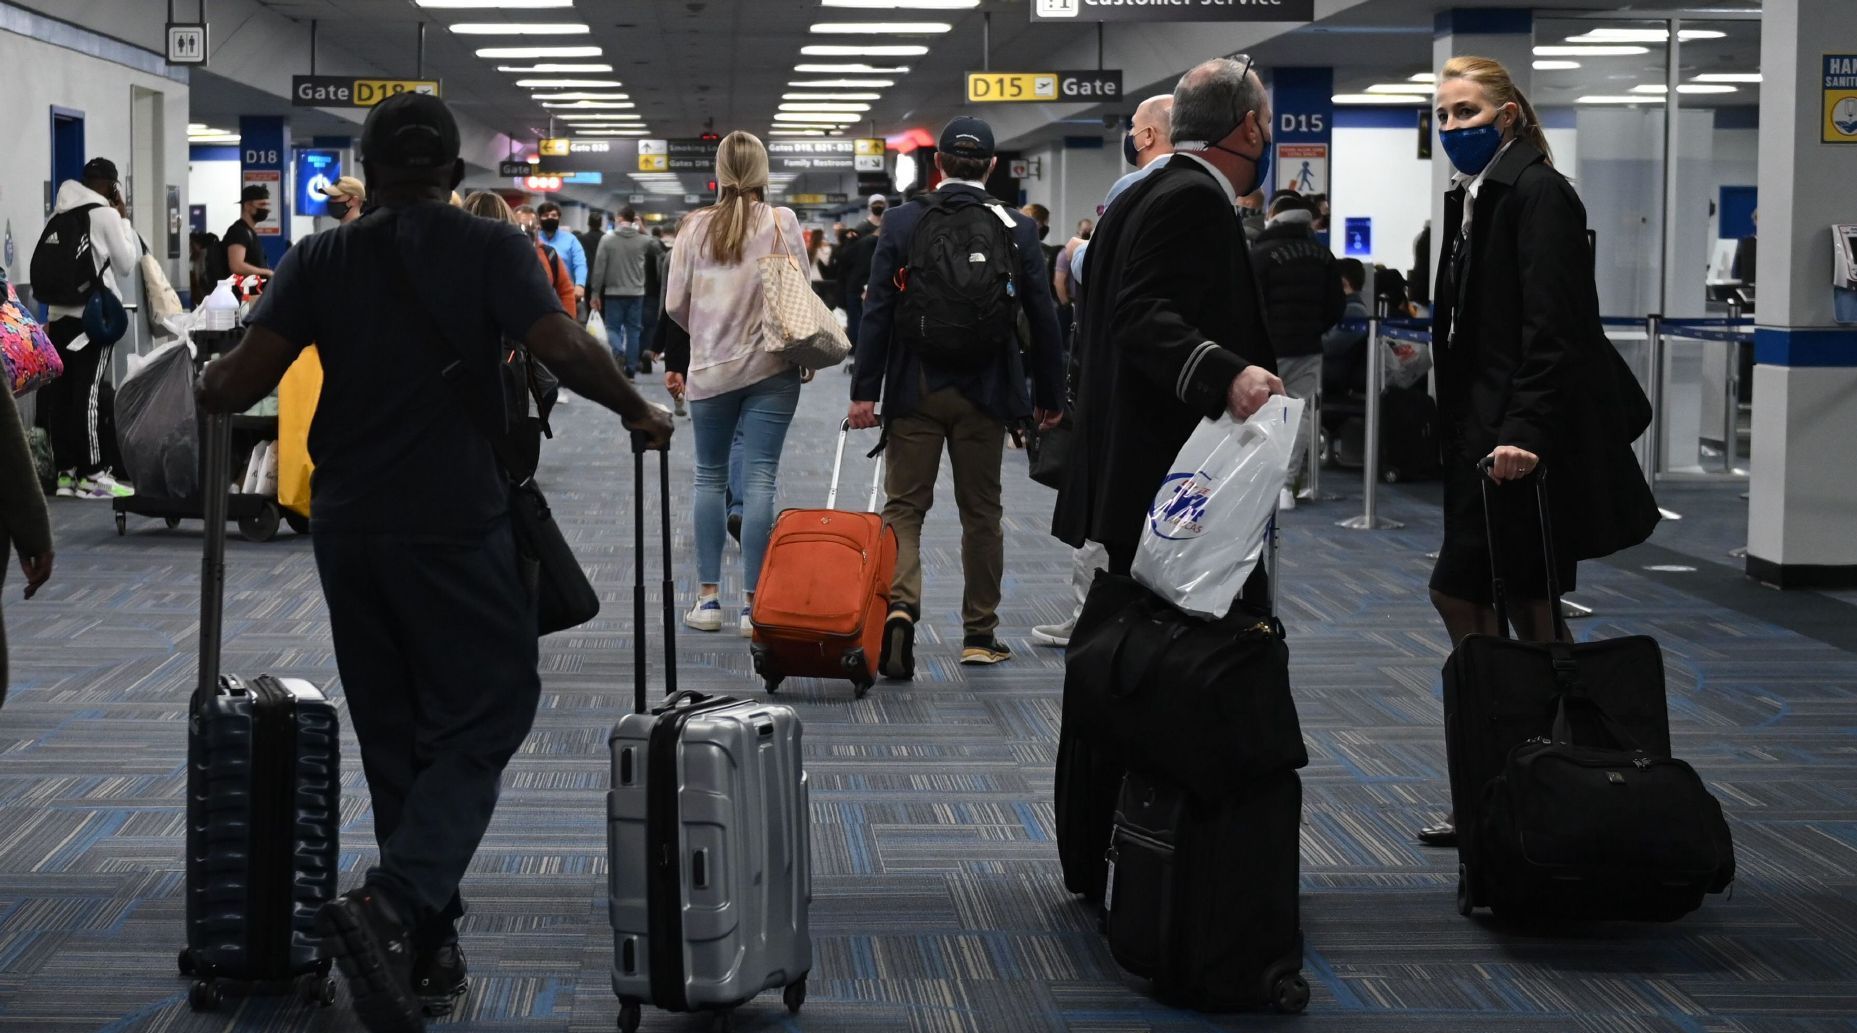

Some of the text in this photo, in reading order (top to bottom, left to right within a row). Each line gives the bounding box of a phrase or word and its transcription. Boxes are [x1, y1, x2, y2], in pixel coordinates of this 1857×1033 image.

[298, 83, 349, 100] Gate
[973, 77, 1116, 97] D15 Gate
[1281, 113, 1323, 132] D15
[570, 143, 590, 152] Gate
[246, 150, 277, 164] D18
[783, 158, 854, 168] Family Restroom
[503, 164, 530, 174] Gate
